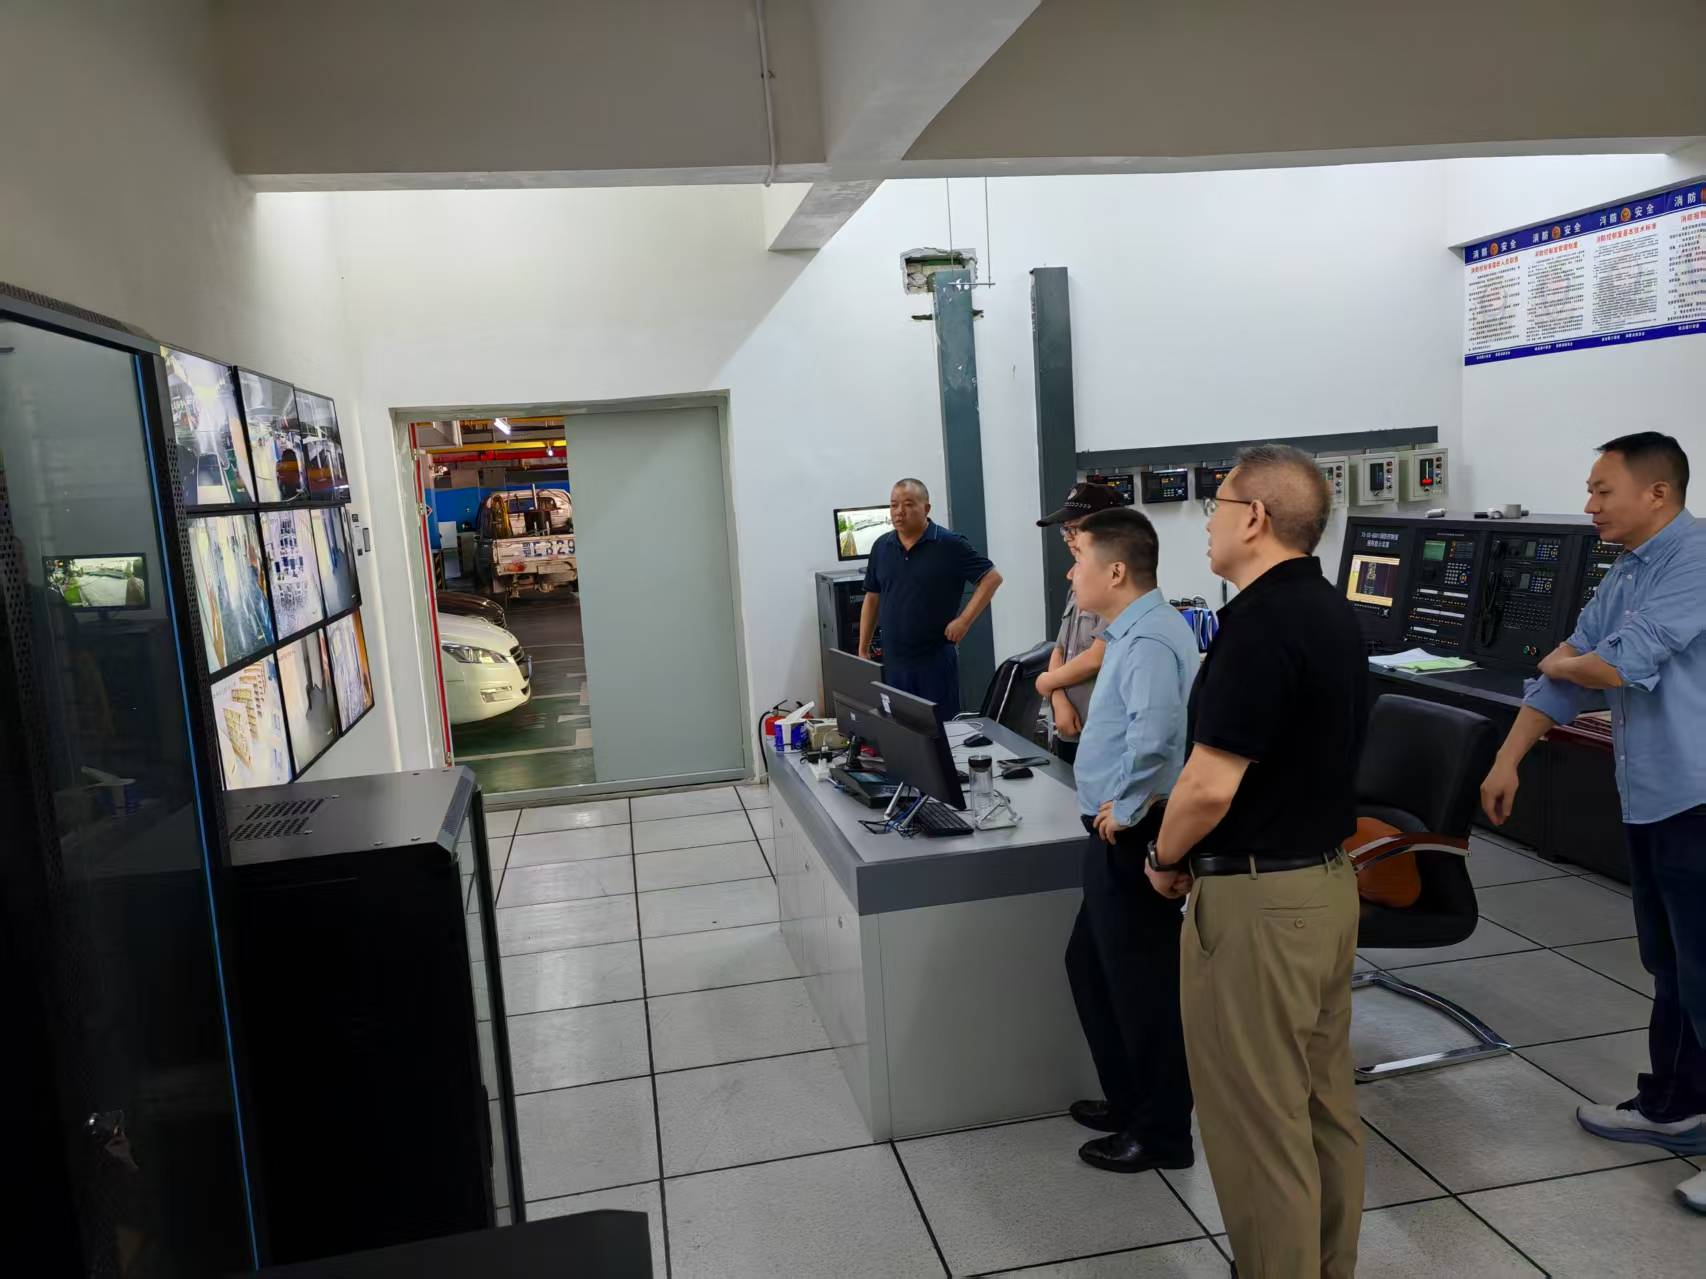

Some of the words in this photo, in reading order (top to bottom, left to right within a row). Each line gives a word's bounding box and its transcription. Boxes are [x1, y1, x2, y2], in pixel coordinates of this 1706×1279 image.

[1674, 191, 1696, 207] 消防
[1600, 213, 1617, 227] 消防
[1634, 203, 1654, 218] 安全
[1532, 231, 1549, 244] 消防
[1564, 222, 1582, 236] 安全
[1501, 239, 1517, 252] 安全
